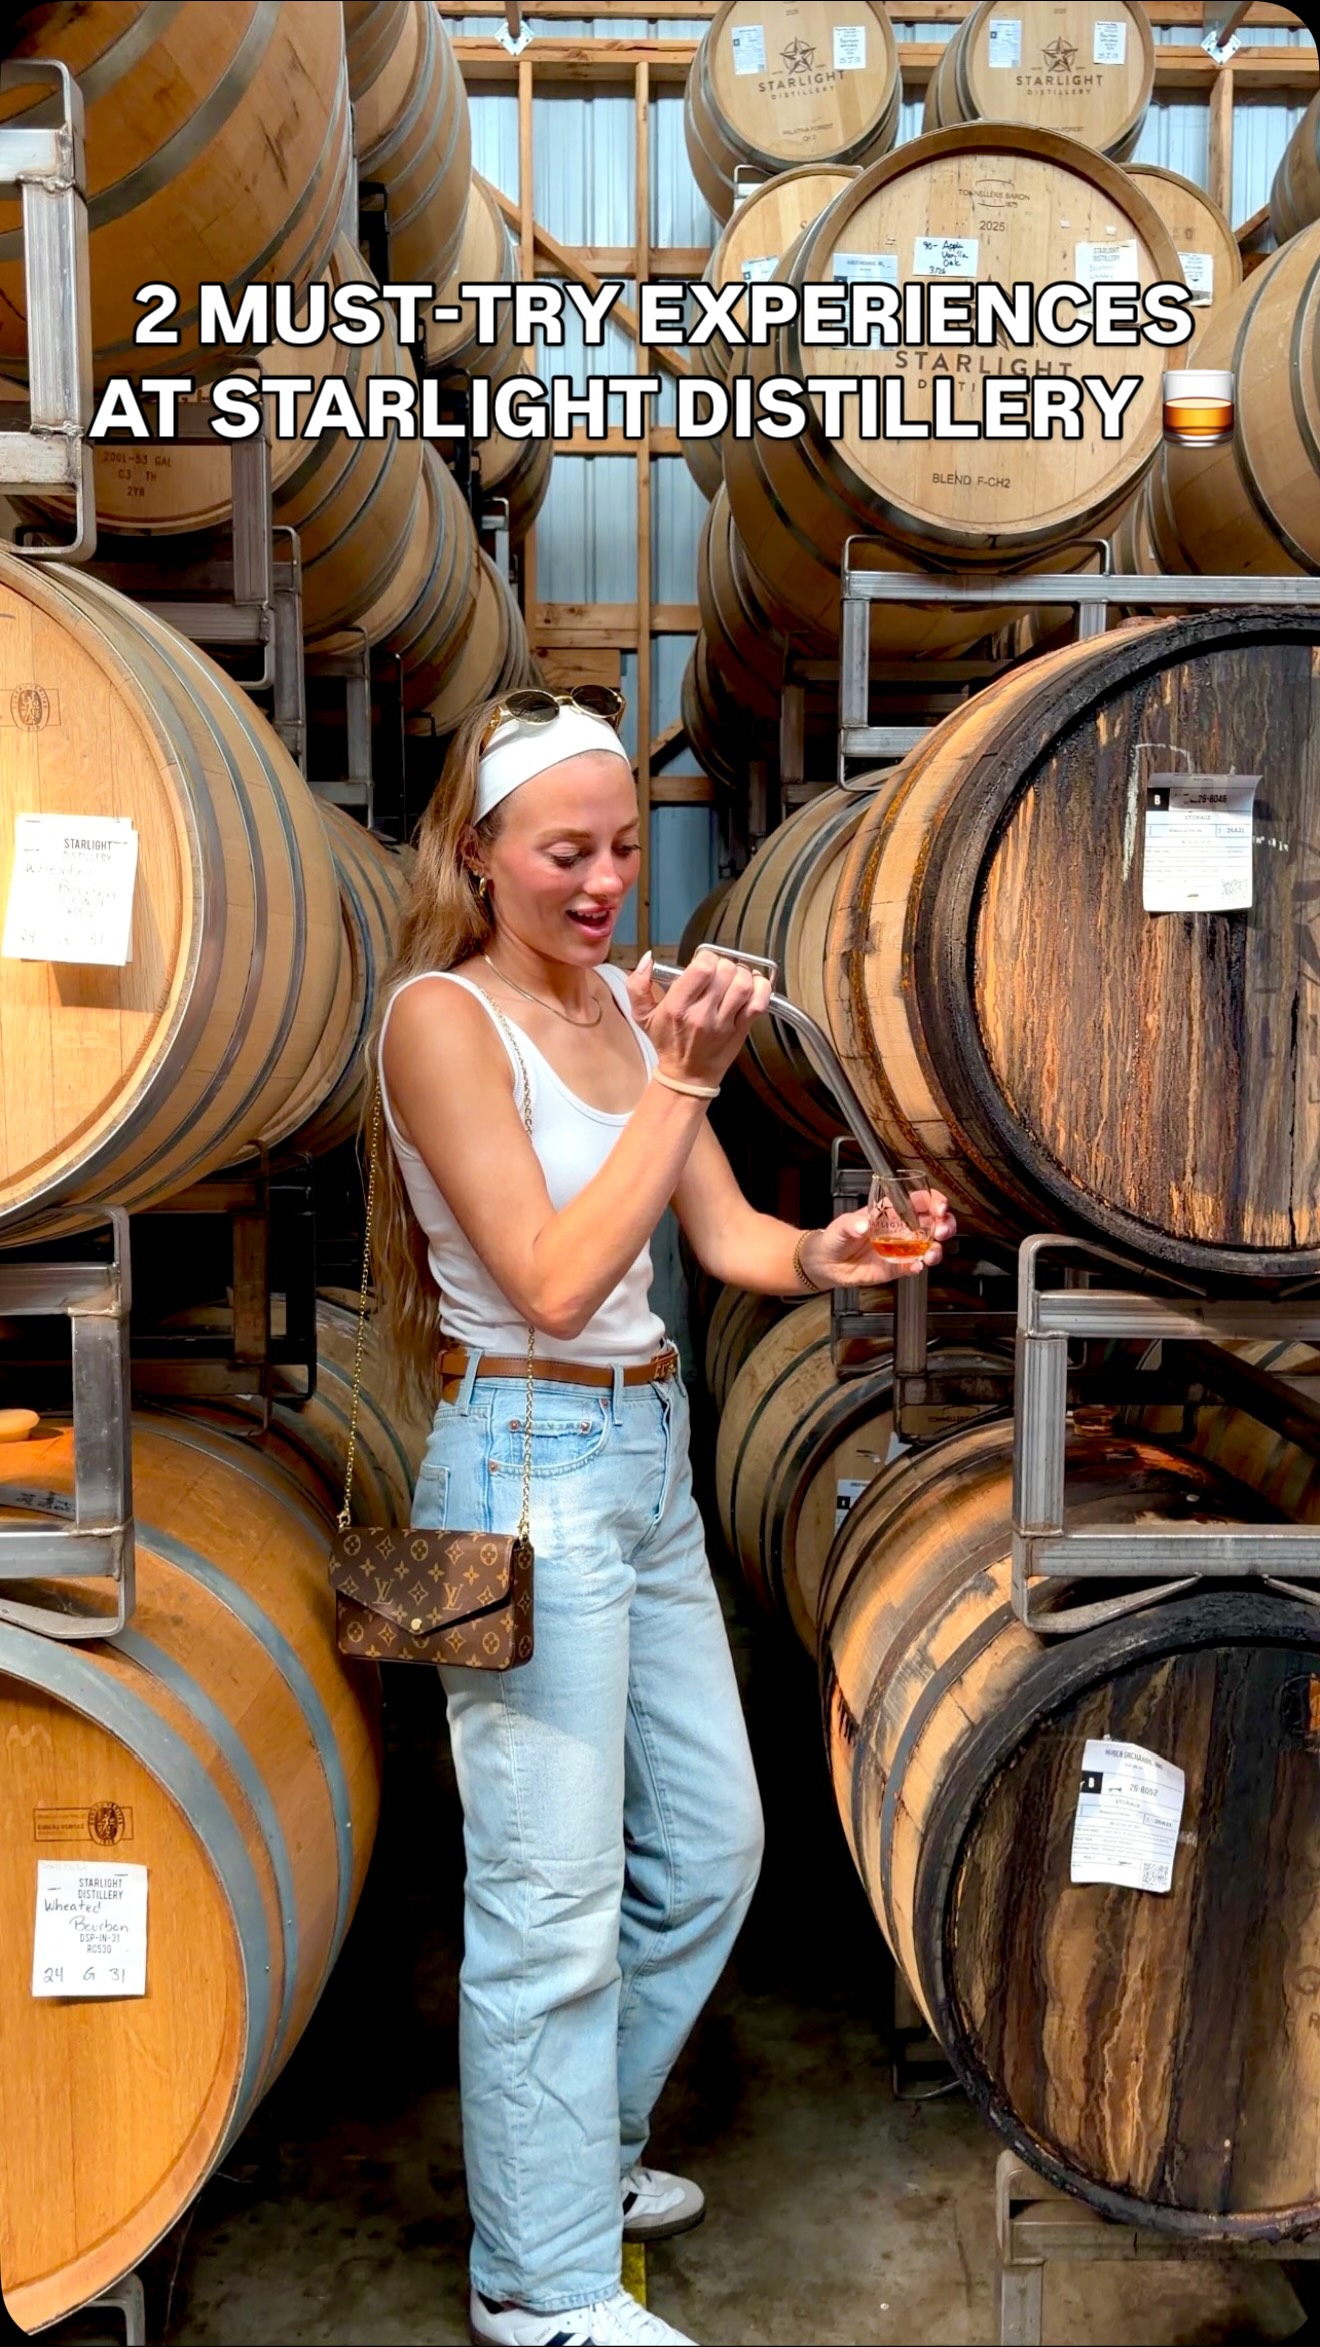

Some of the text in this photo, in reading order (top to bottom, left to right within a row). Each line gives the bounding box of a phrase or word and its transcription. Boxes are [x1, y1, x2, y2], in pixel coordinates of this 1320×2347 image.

[757, 69, 845, 93] STARLIGHT
[1015, 74, 1104, 88] STARLIGHT
[770, 85, 836, 101] DISTILLERY
[1026, 88, 1092, 96] DISTILLERY
[978, 219, 1006, 232] 2025
[941, 250, 969, 260] Vanilla
[942, 258, 962, 267] Oak
[894, 349, 1073, 376] STARLIGHT
[154, 455, 173, 468] GAL
[931, 472, 1012, 489] BLEND F-CH2
[63, 837, 113, 851] STARLIGHT
[1087, 1776, 1095, 1788] B
[78, 1877, 124, 1889] STARLIGHT
[77, 1888, 124, 1900] DISTILLERY
[44, 1897, 101, 1914] Wheated
[68, 1914, 130, 1933] Bourbon
[79, 1933, 121, 1943] DSP-IN-31
[43, 1966, 126, 1983] 24 G 31
